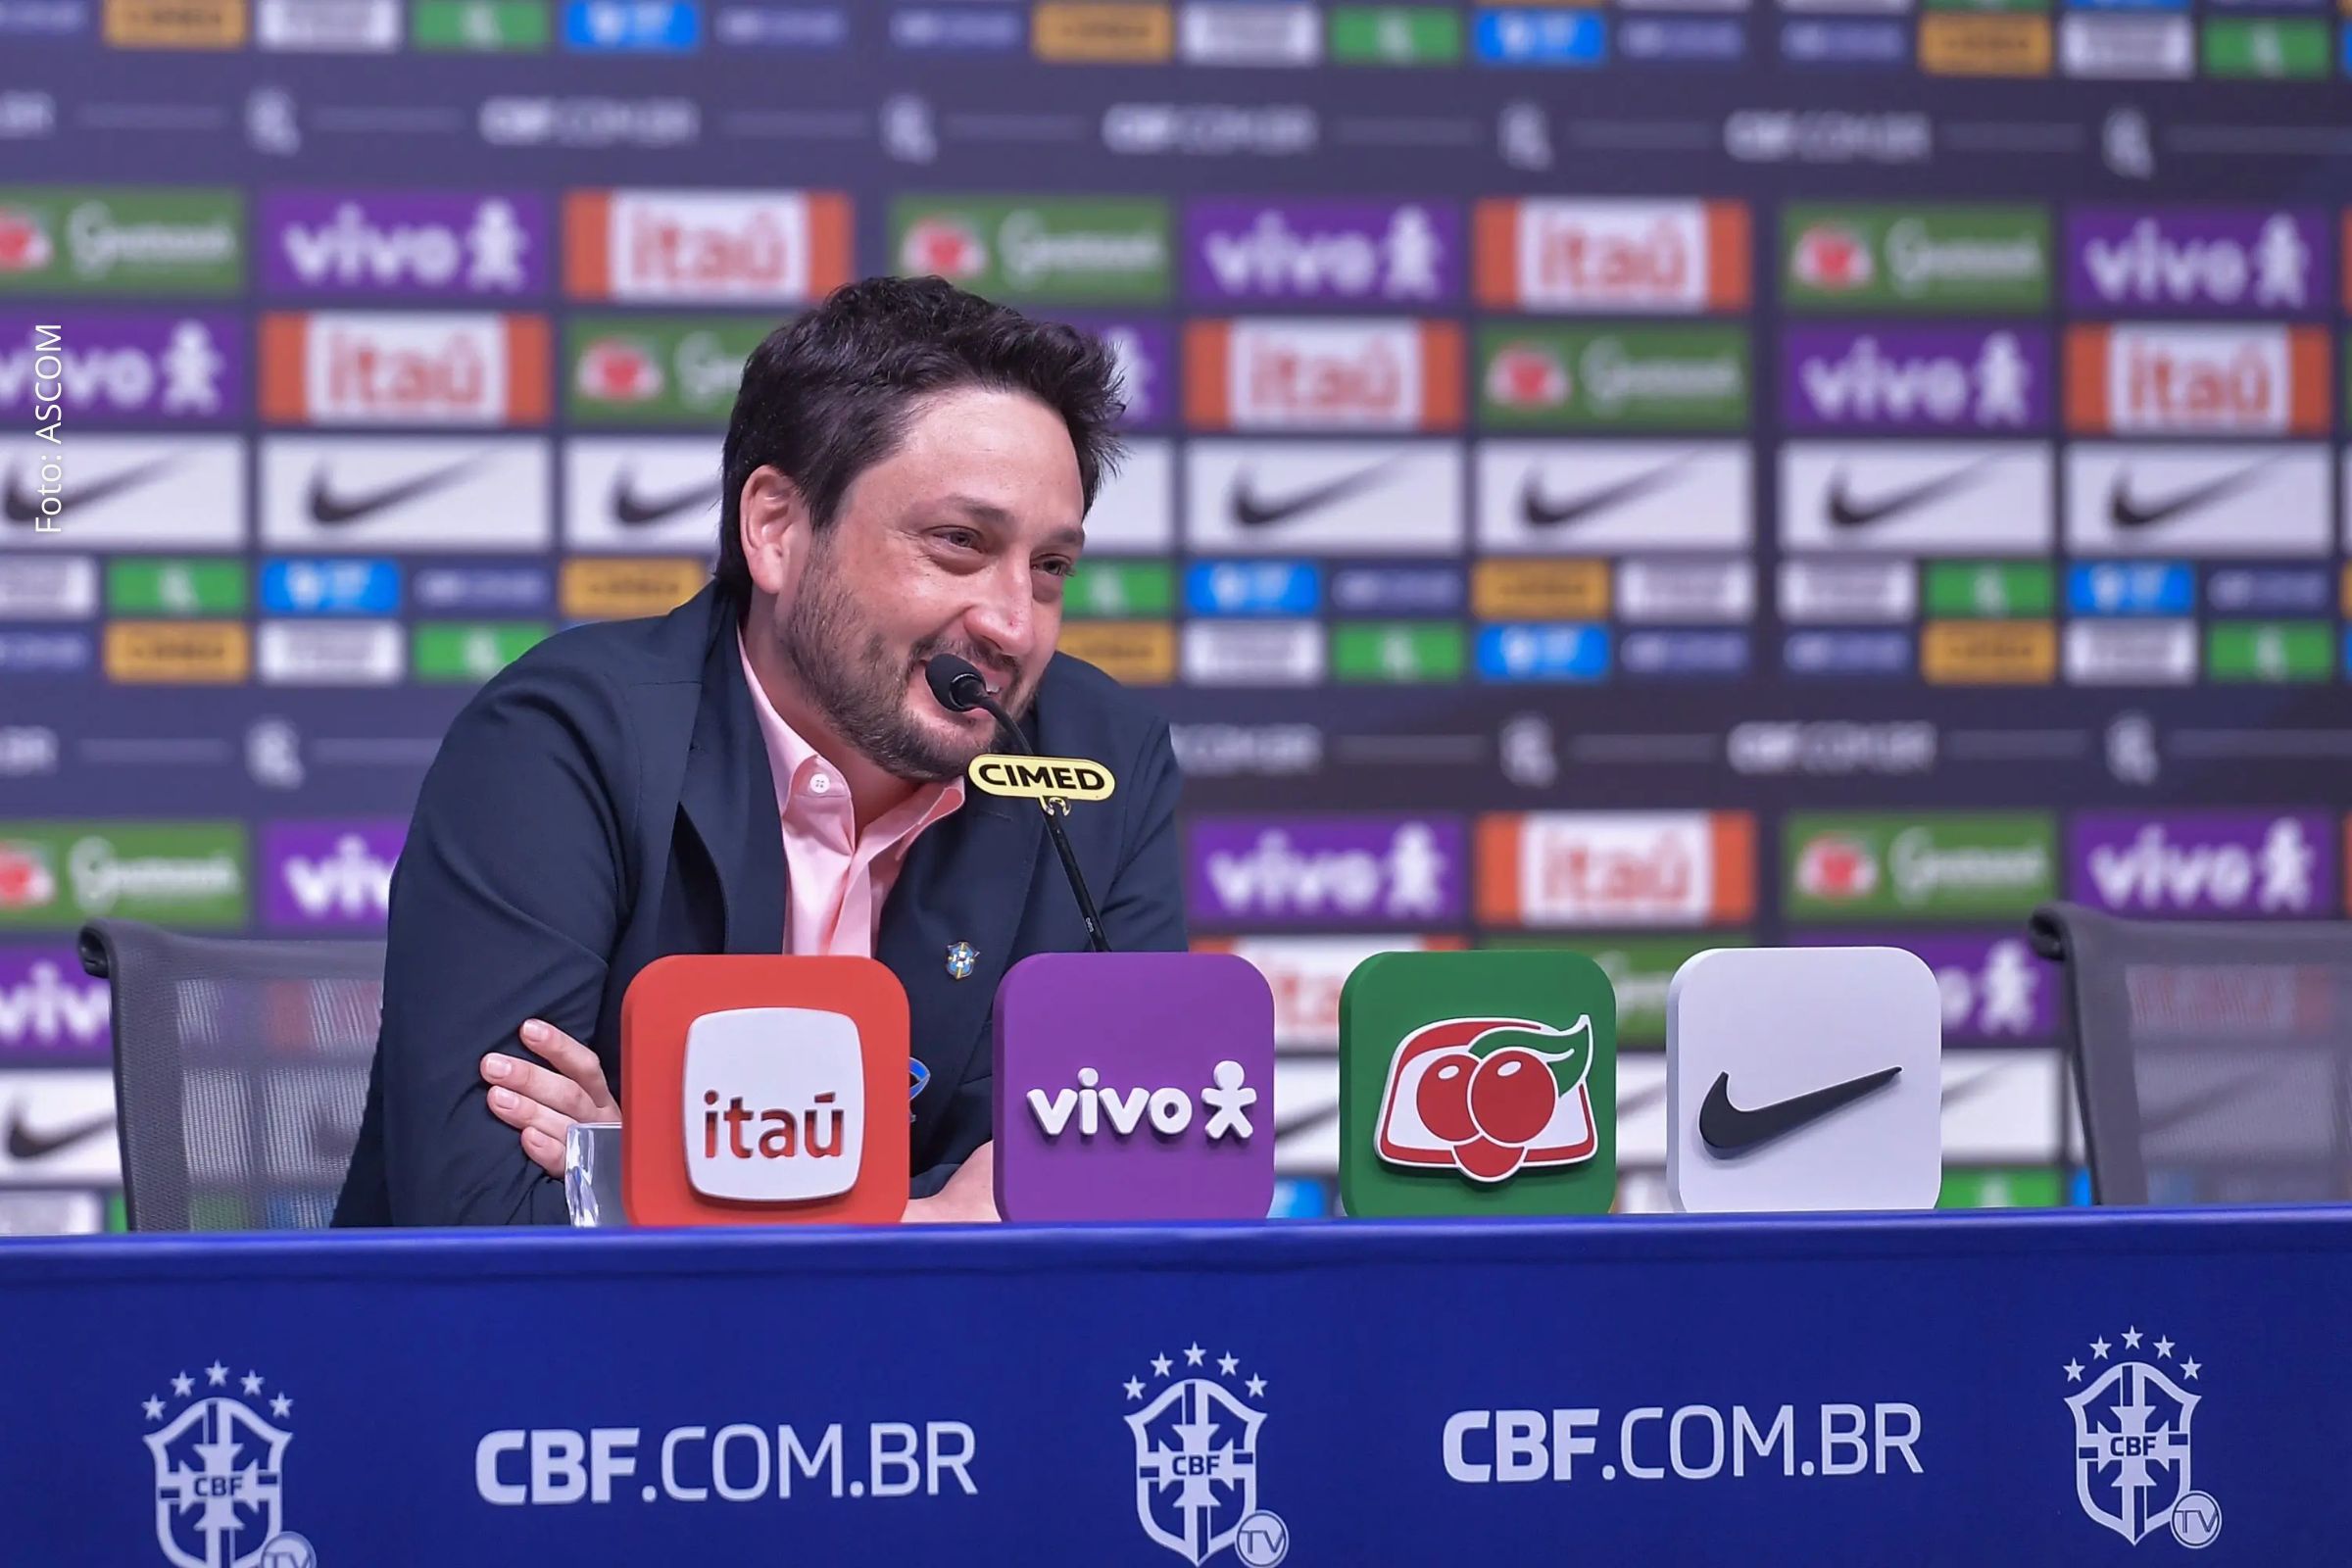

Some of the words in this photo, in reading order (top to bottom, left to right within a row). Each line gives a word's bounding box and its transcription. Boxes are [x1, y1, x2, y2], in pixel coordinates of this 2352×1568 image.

[979, 764, 1104, 790] CIMED
[1027, 1067, 1193, 1135] vivo
[704, 1090, 844, 1158] itaú
[1443, 1402, 1924, 1483] CBF.COM.BR
[2110, 1436, 2156, 1457] CBF
[476, 1421, 977, 1503] CBF.COM.BR
[1172, 1455, 1220, 1476] CBF
[194, 1477, 243, 1496] CBF
[2174, 1509, 2218, 1534] TV
[1240, 1530, 1286, 1554] TV
